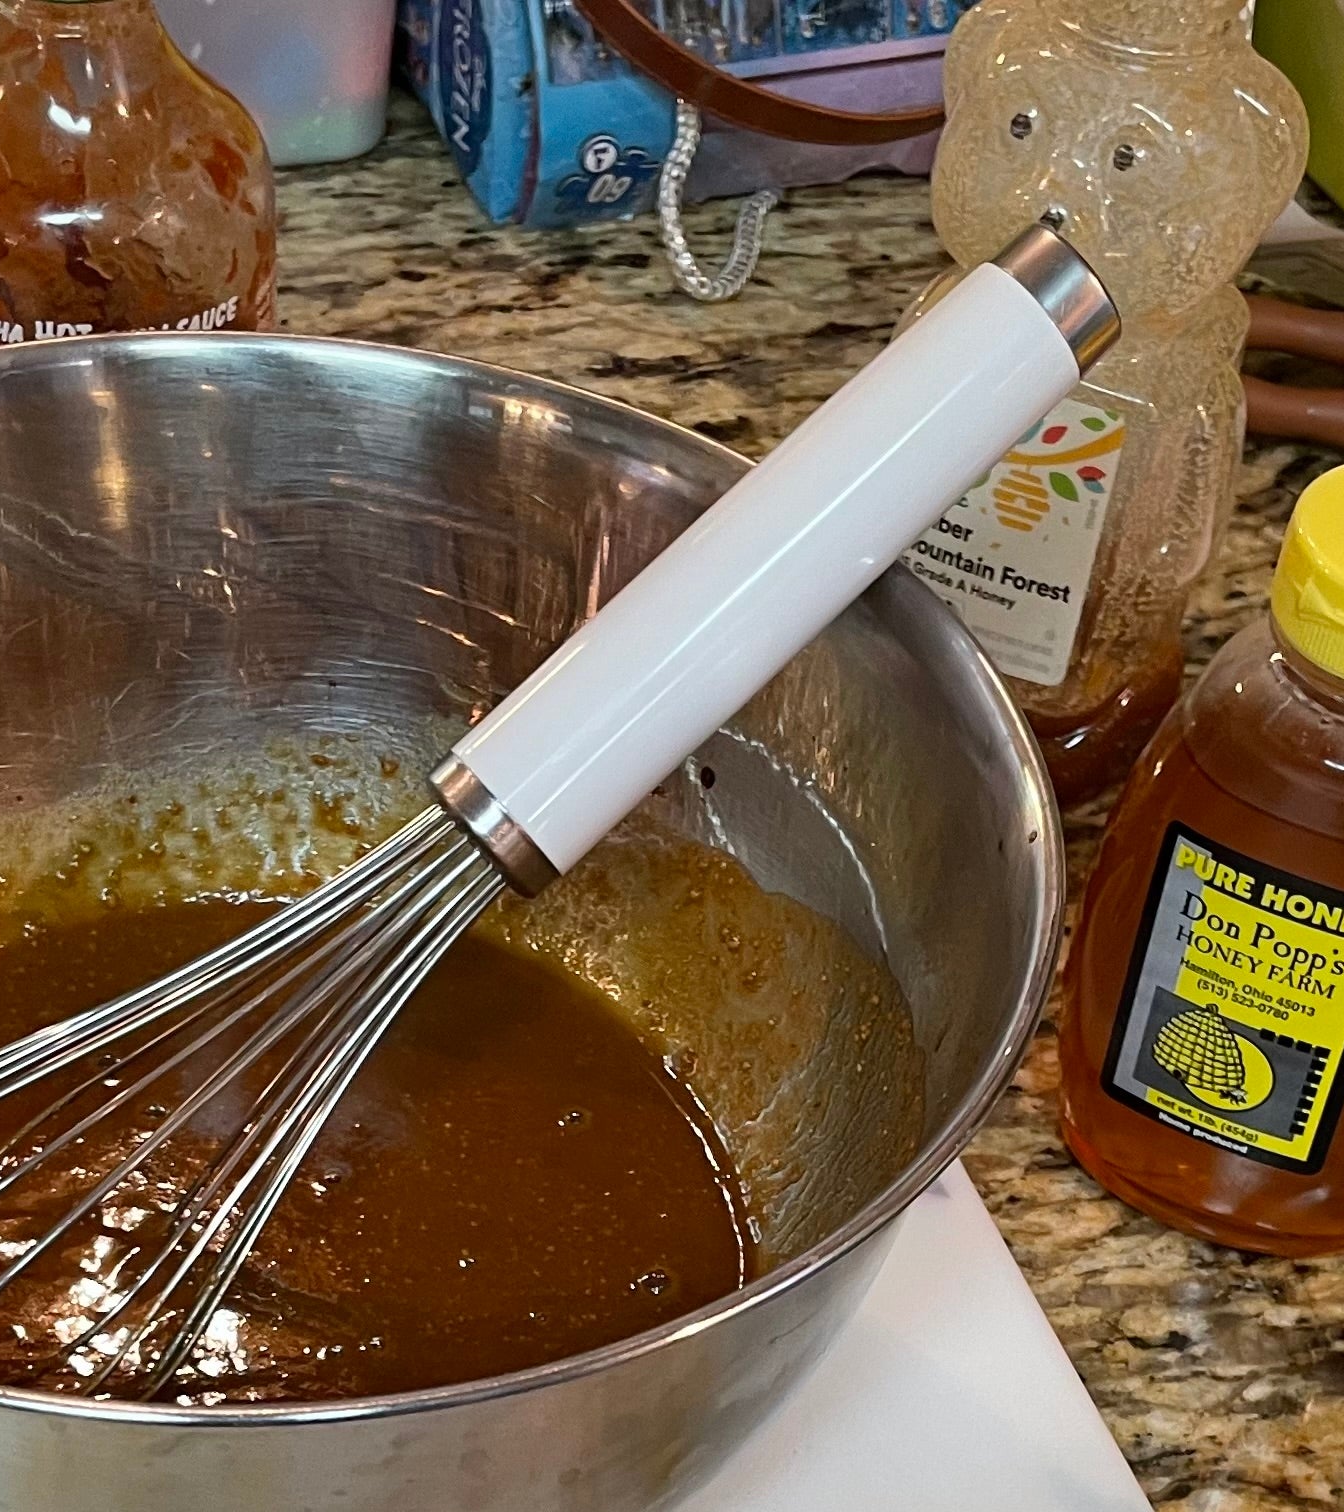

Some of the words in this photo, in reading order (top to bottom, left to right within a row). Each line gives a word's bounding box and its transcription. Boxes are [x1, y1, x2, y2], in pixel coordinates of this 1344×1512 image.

[176, 295, 240, 331] SAUCE
[911, 539, 995, 581] ountain
[1000, 565, 1071, 604] Forest
[955, 578, 968, 592] A
[970, 582, 1017, 611] Honey
[1175, 843, 1256, 900] PURE
[1179, 890, 1241, 940] Don
[1175, 924, 1265, 976] HONEY
[1267, 963, 1337, 1000] FARM
[1179, 956, 1240, 992] Hamilton,
[1241, 983, 1274, 1004] Ohio
[1275, 996, 1317, 1018] 45013
[1196, 977, 1230, 1001] (513)
